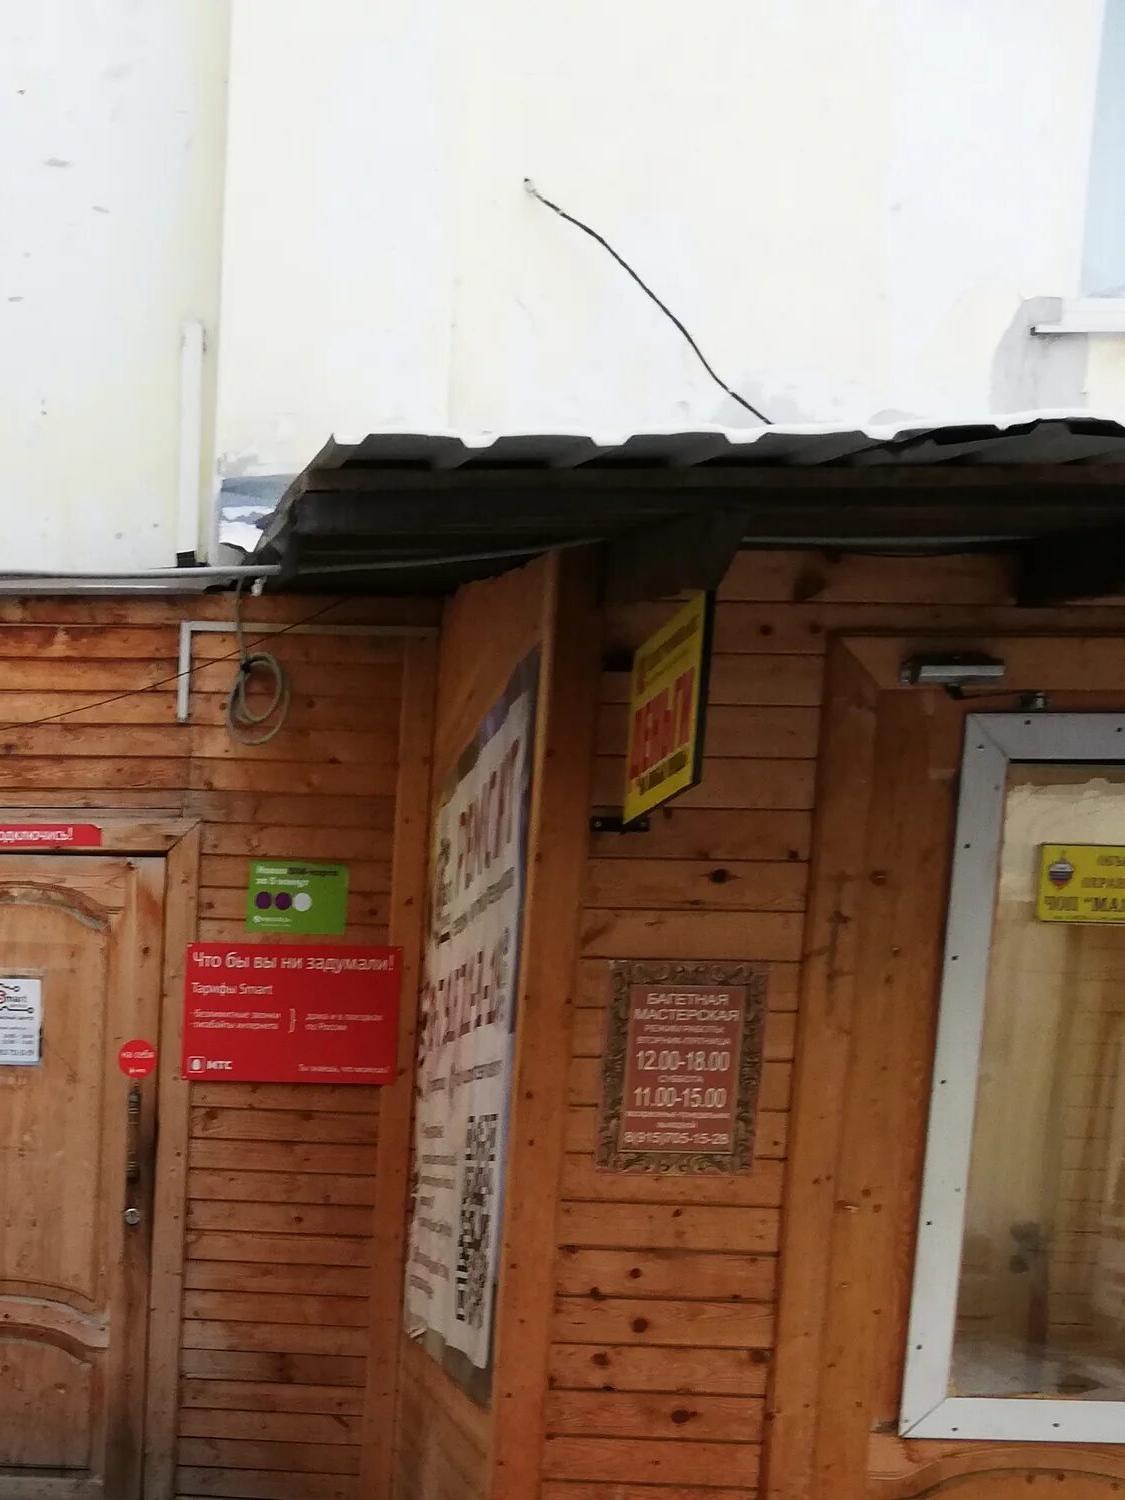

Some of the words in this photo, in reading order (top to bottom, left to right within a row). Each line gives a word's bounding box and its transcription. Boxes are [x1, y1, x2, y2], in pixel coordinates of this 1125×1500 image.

[192, 952, 222, 968] Что
[225, 952, 248, 968] бы
[254, 956, 276, 969] вы
[280, 957, 303, 970] ни
[306, 955, 395, 974] задумали!
[191, 982, 237, 996] Тарифы
[239, 983, 273, 996] Smart
[646, 993, 729, 1006] БАГЕТНАЯ
[633, 1008, 740, 1021] МАСТЕРСКАЯ
[207, 1060, 232, 1070] МТС
[636, 1050, 730, 1071] 12.00-18.00
[633, 1087, 727, 1107] 11.00-15.00
